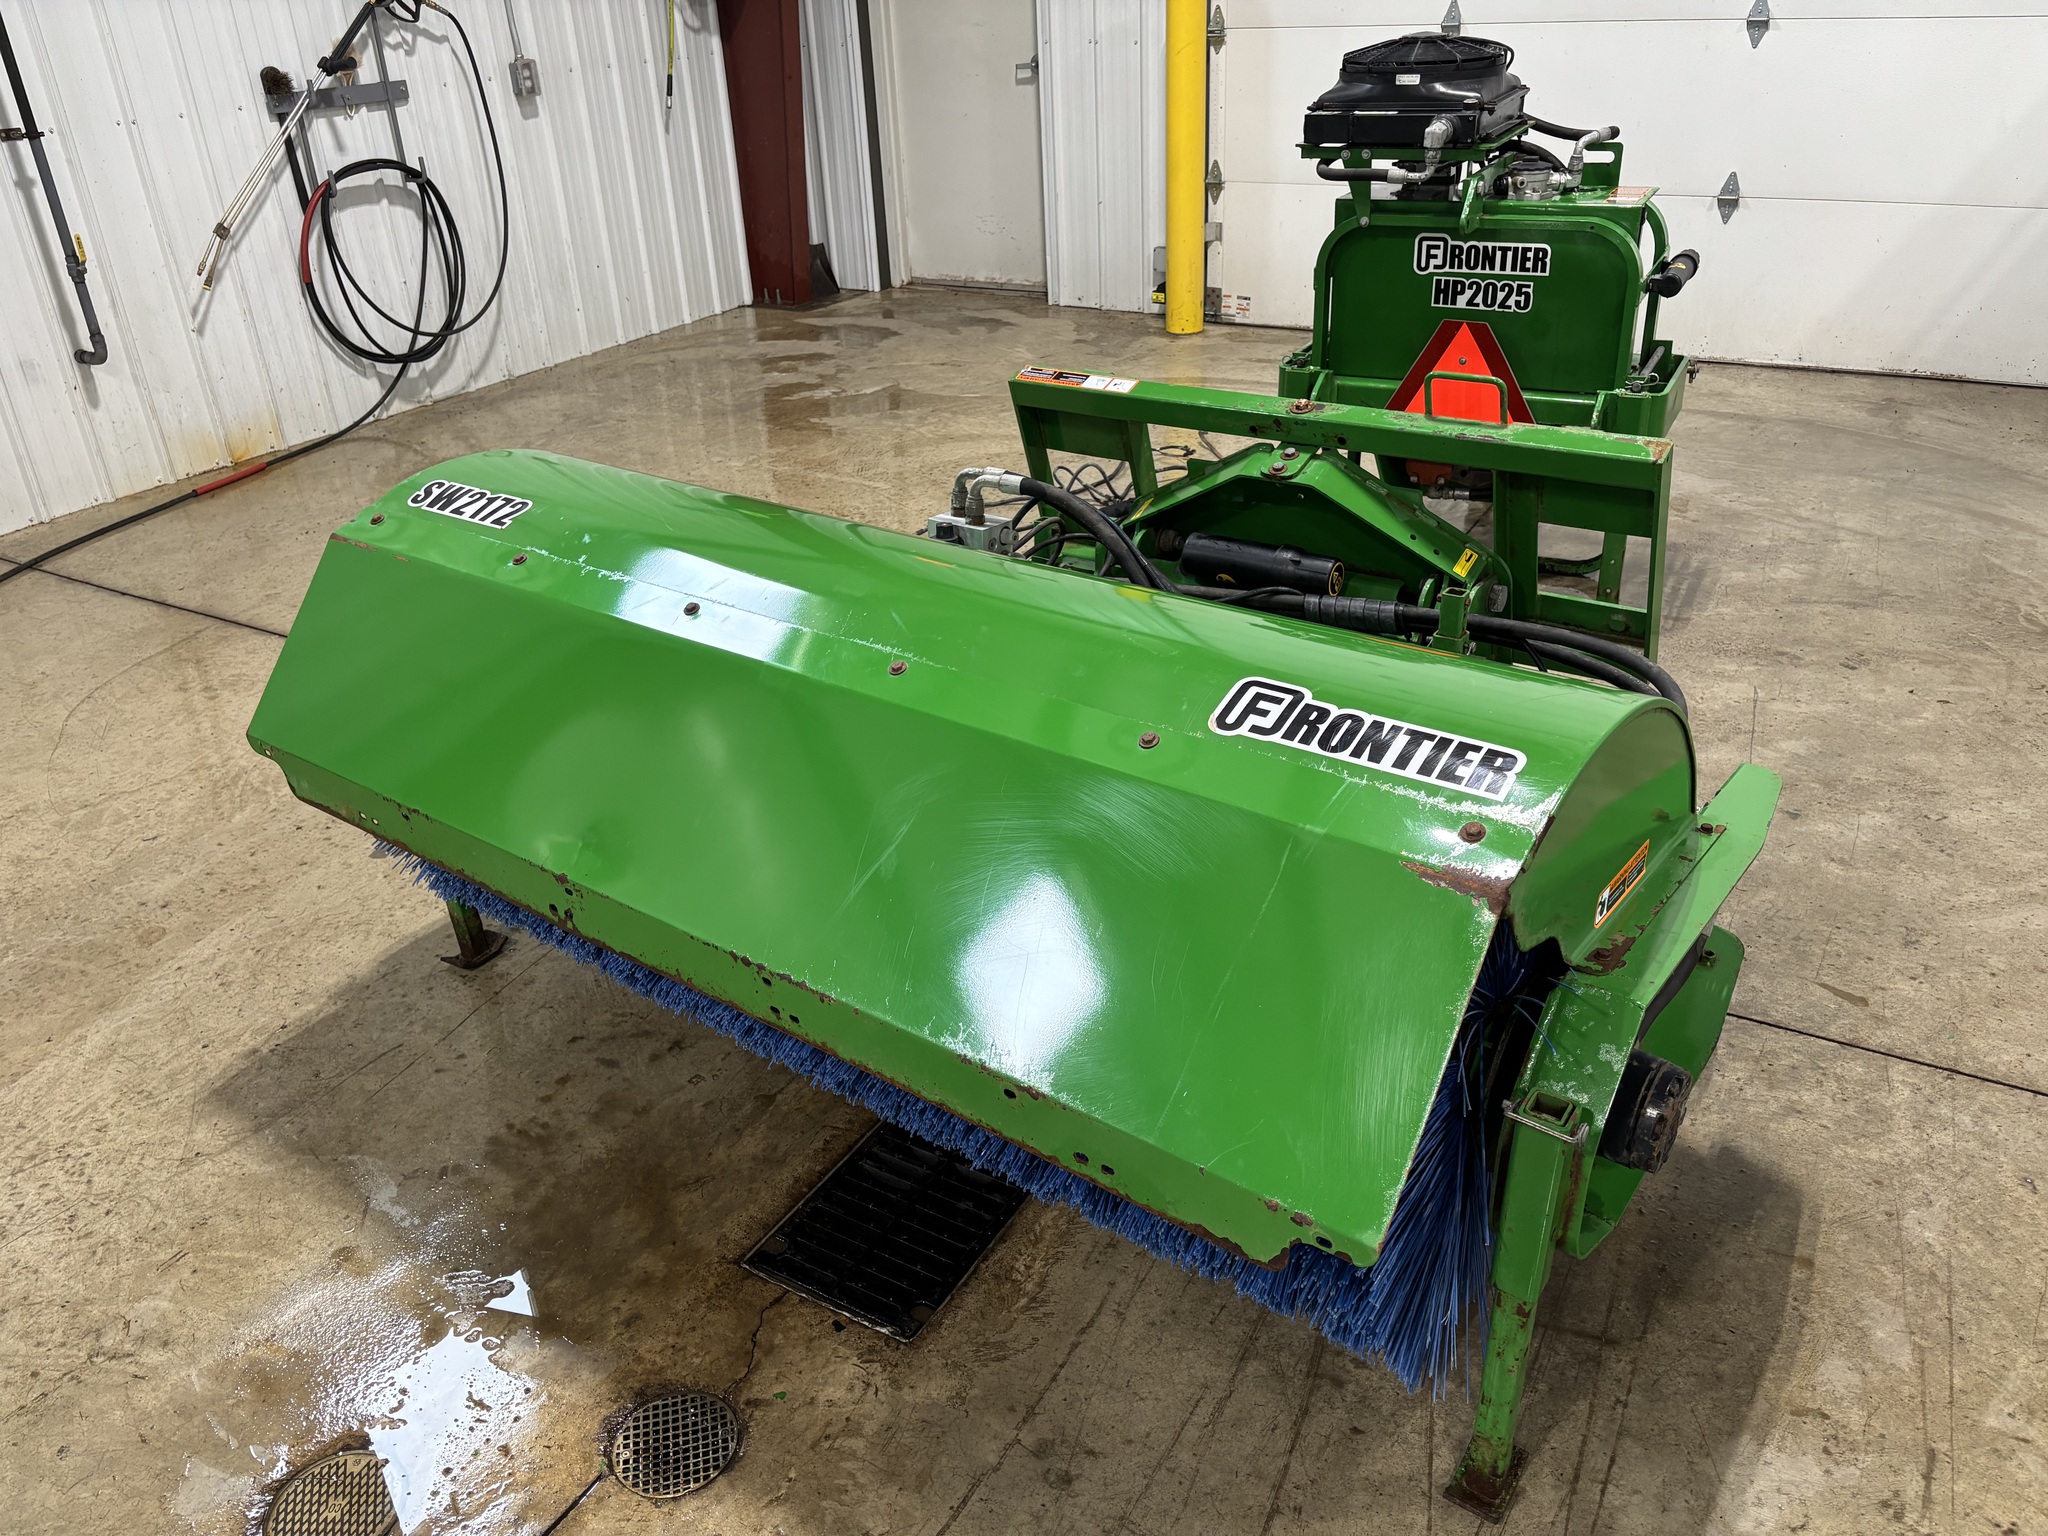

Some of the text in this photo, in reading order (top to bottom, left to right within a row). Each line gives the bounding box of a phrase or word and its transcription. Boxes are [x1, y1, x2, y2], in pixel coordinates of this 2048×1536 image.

[1416, 236, 1549, 273] FRONTIER
[1433, 278, 1532, 311] HP2025
[411, 481, 529, 527] SW2172
[1216, 680, 1519, 795] FRONTIER
